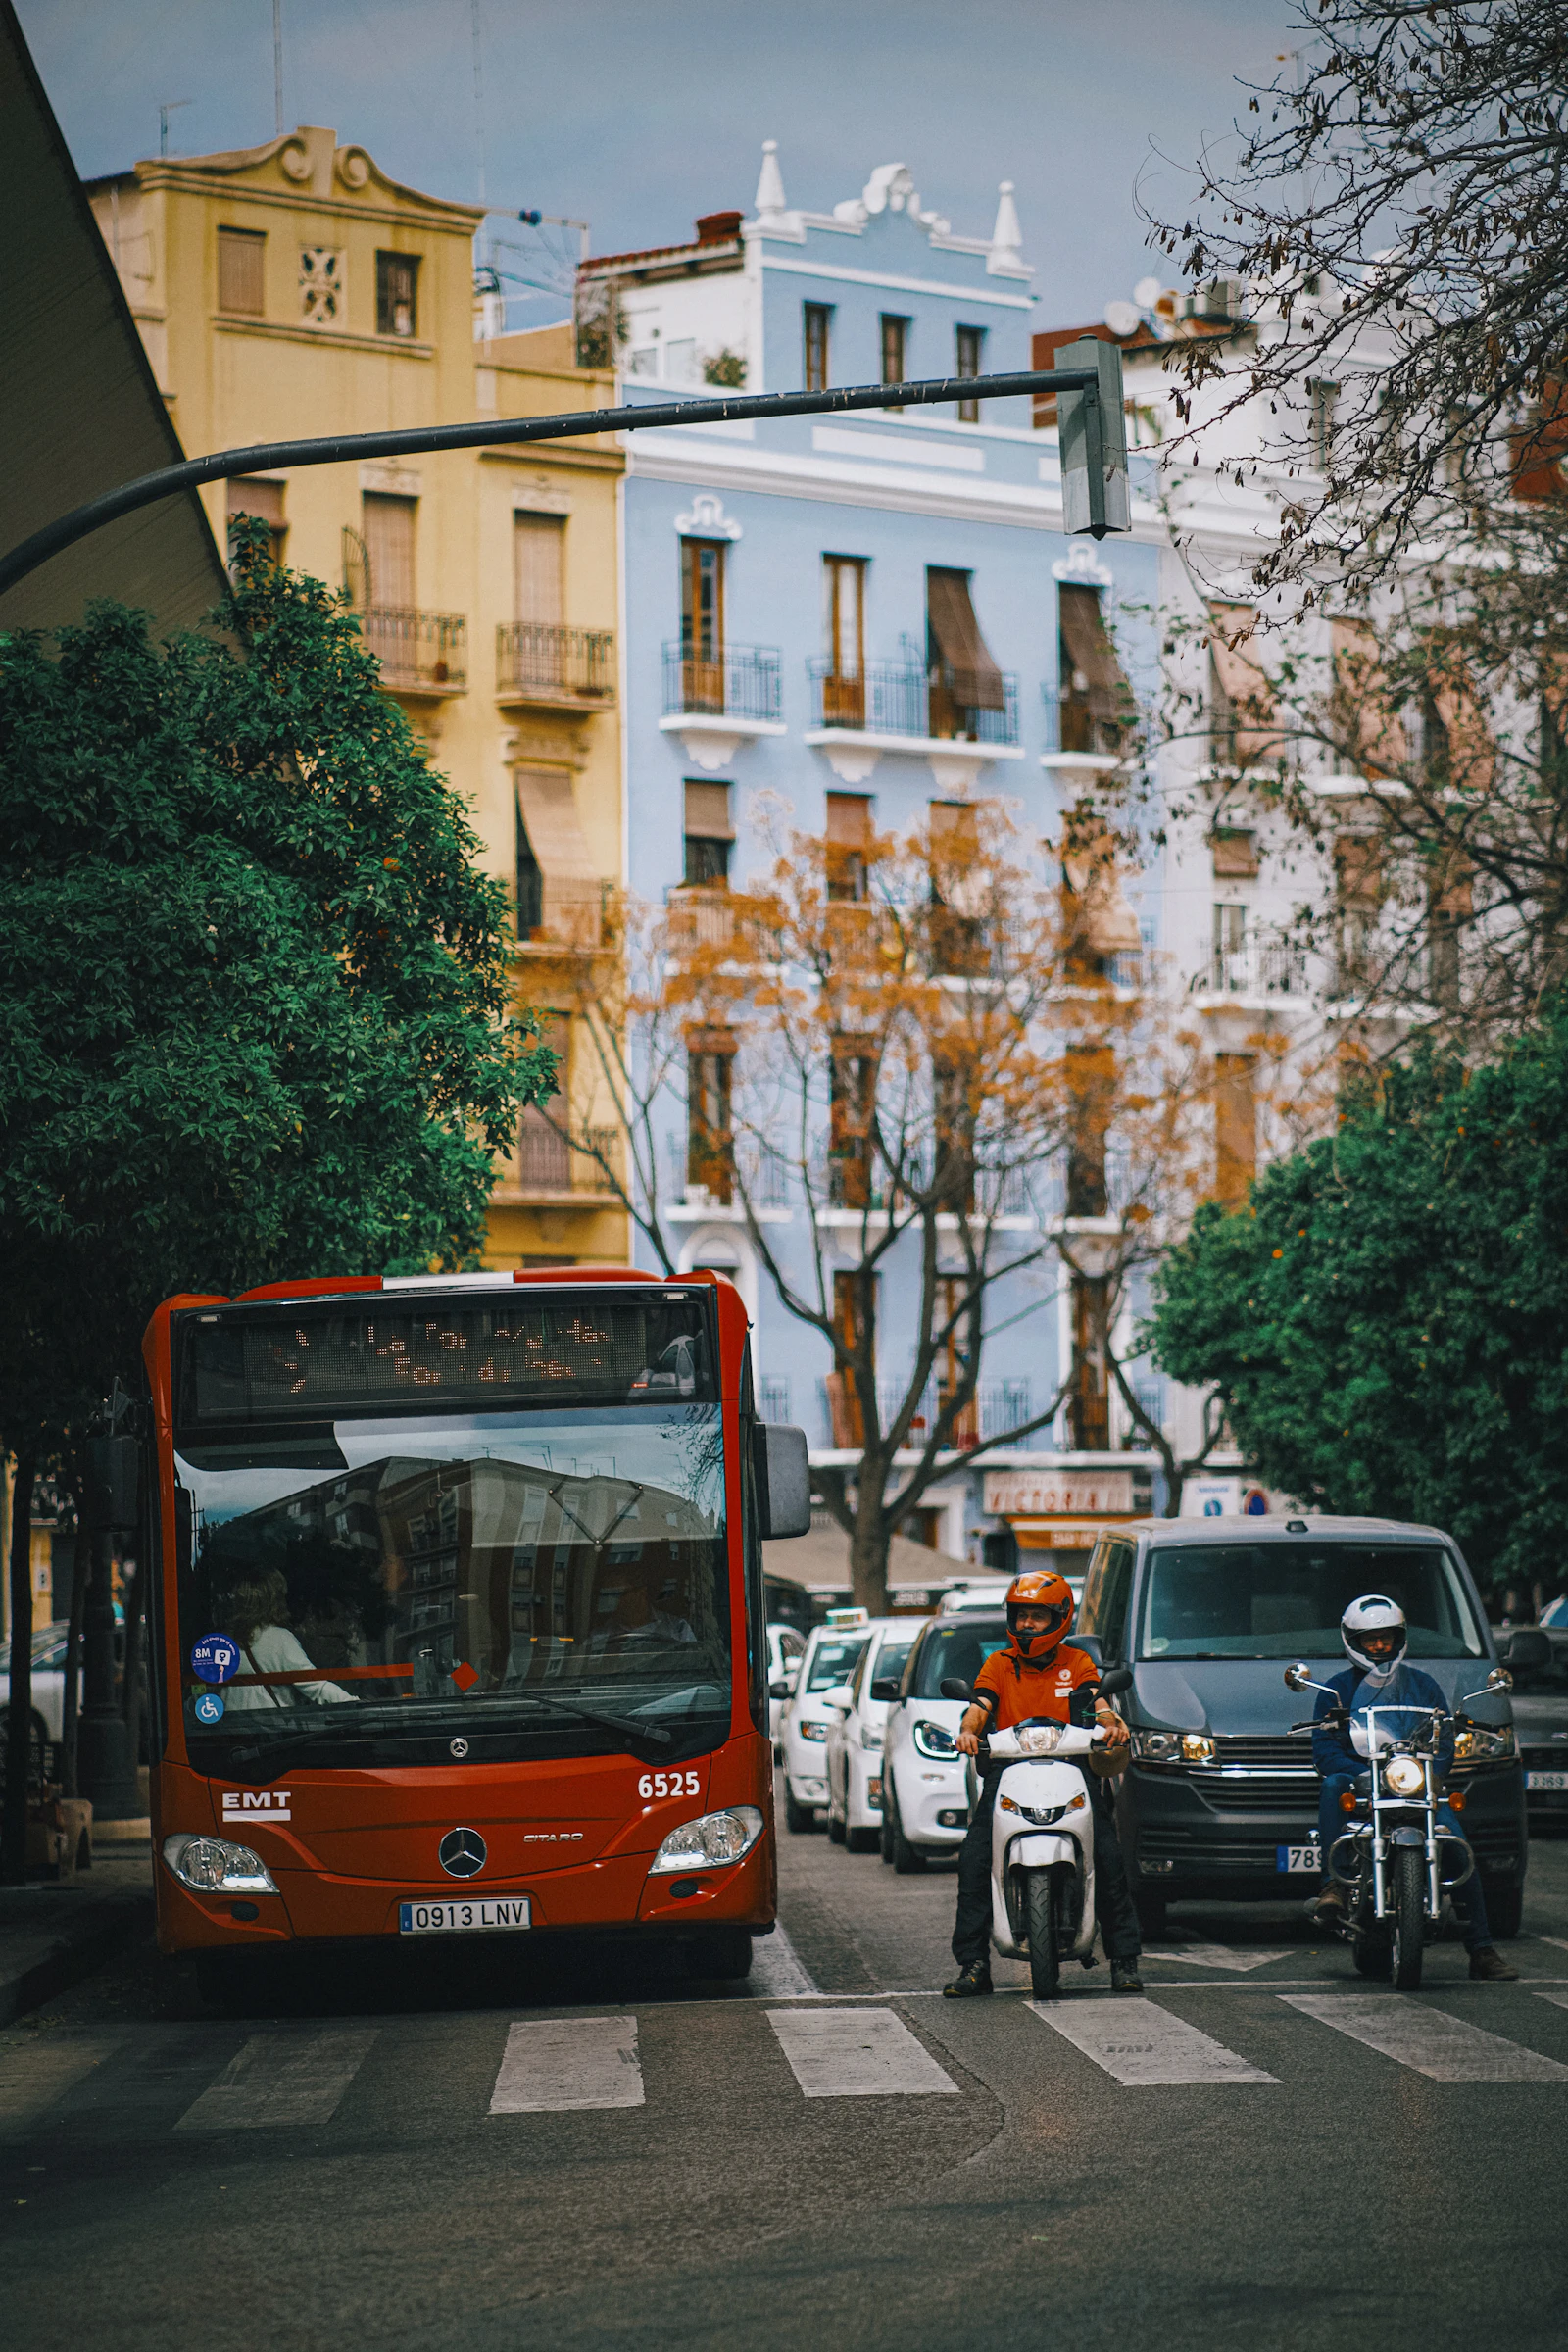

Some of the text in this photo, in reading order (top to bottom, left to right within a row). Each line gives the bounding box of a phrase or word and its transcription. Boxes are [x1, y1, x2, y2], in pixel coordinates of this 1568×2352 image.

[195, 1647, 211, 1658] 8M
[638, 1771, 701, 1799] 6525
[222, 1791, 292, 1809] EMT
[523, 1833, 584, 1842] CITARO
[416, 1905, 473, 1928] 0913
[481, 1902, 523, 1926] LNV
